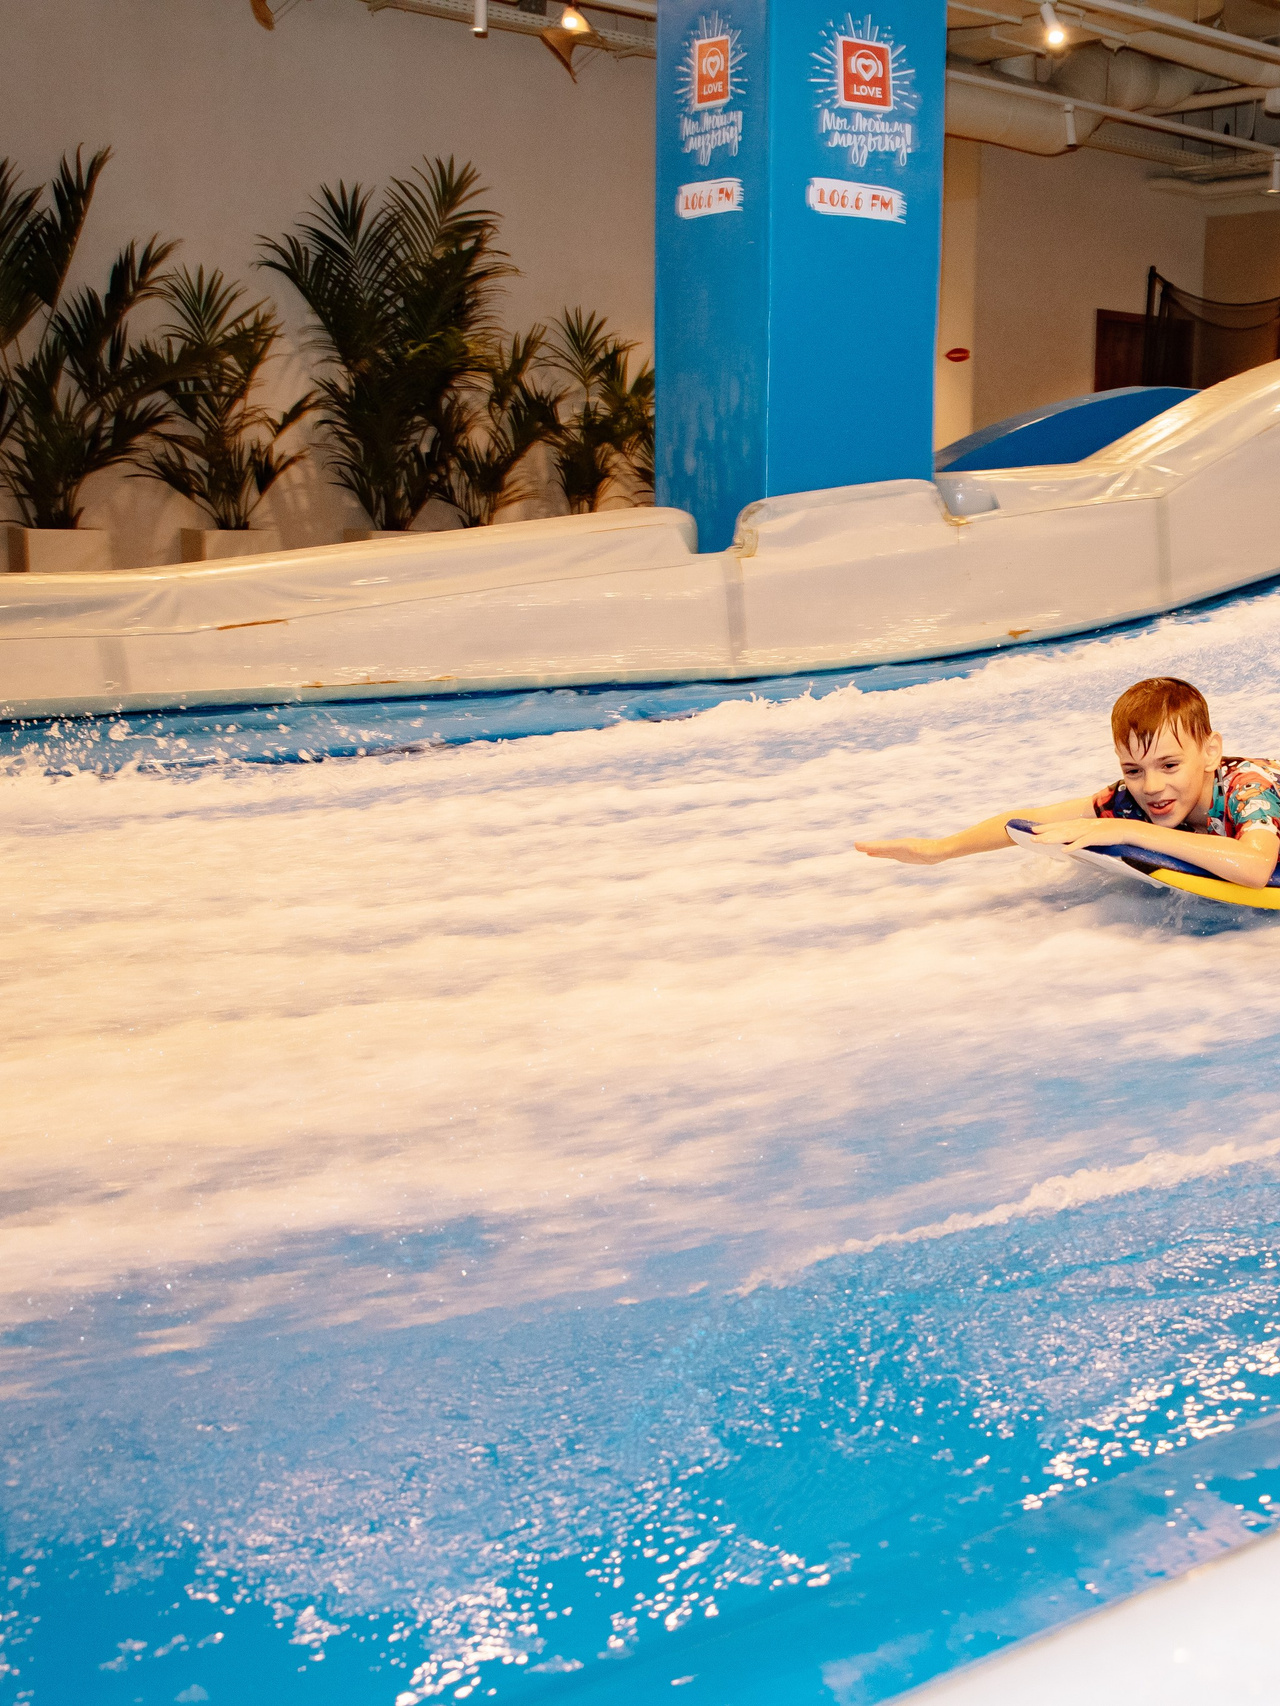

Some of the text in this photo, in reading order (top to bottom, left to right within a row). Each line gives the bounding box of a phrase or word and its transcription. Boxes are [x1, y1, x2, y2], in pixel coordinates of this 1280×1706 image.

[703, 82, 723, 95] LOVE
[853, 84, 883, 98] LOVE
[822, 109, 851, 133] Мы
[684, 187, 735, 211] 106.6 FM
[817, 187, 894, 214] 106.6 FM
